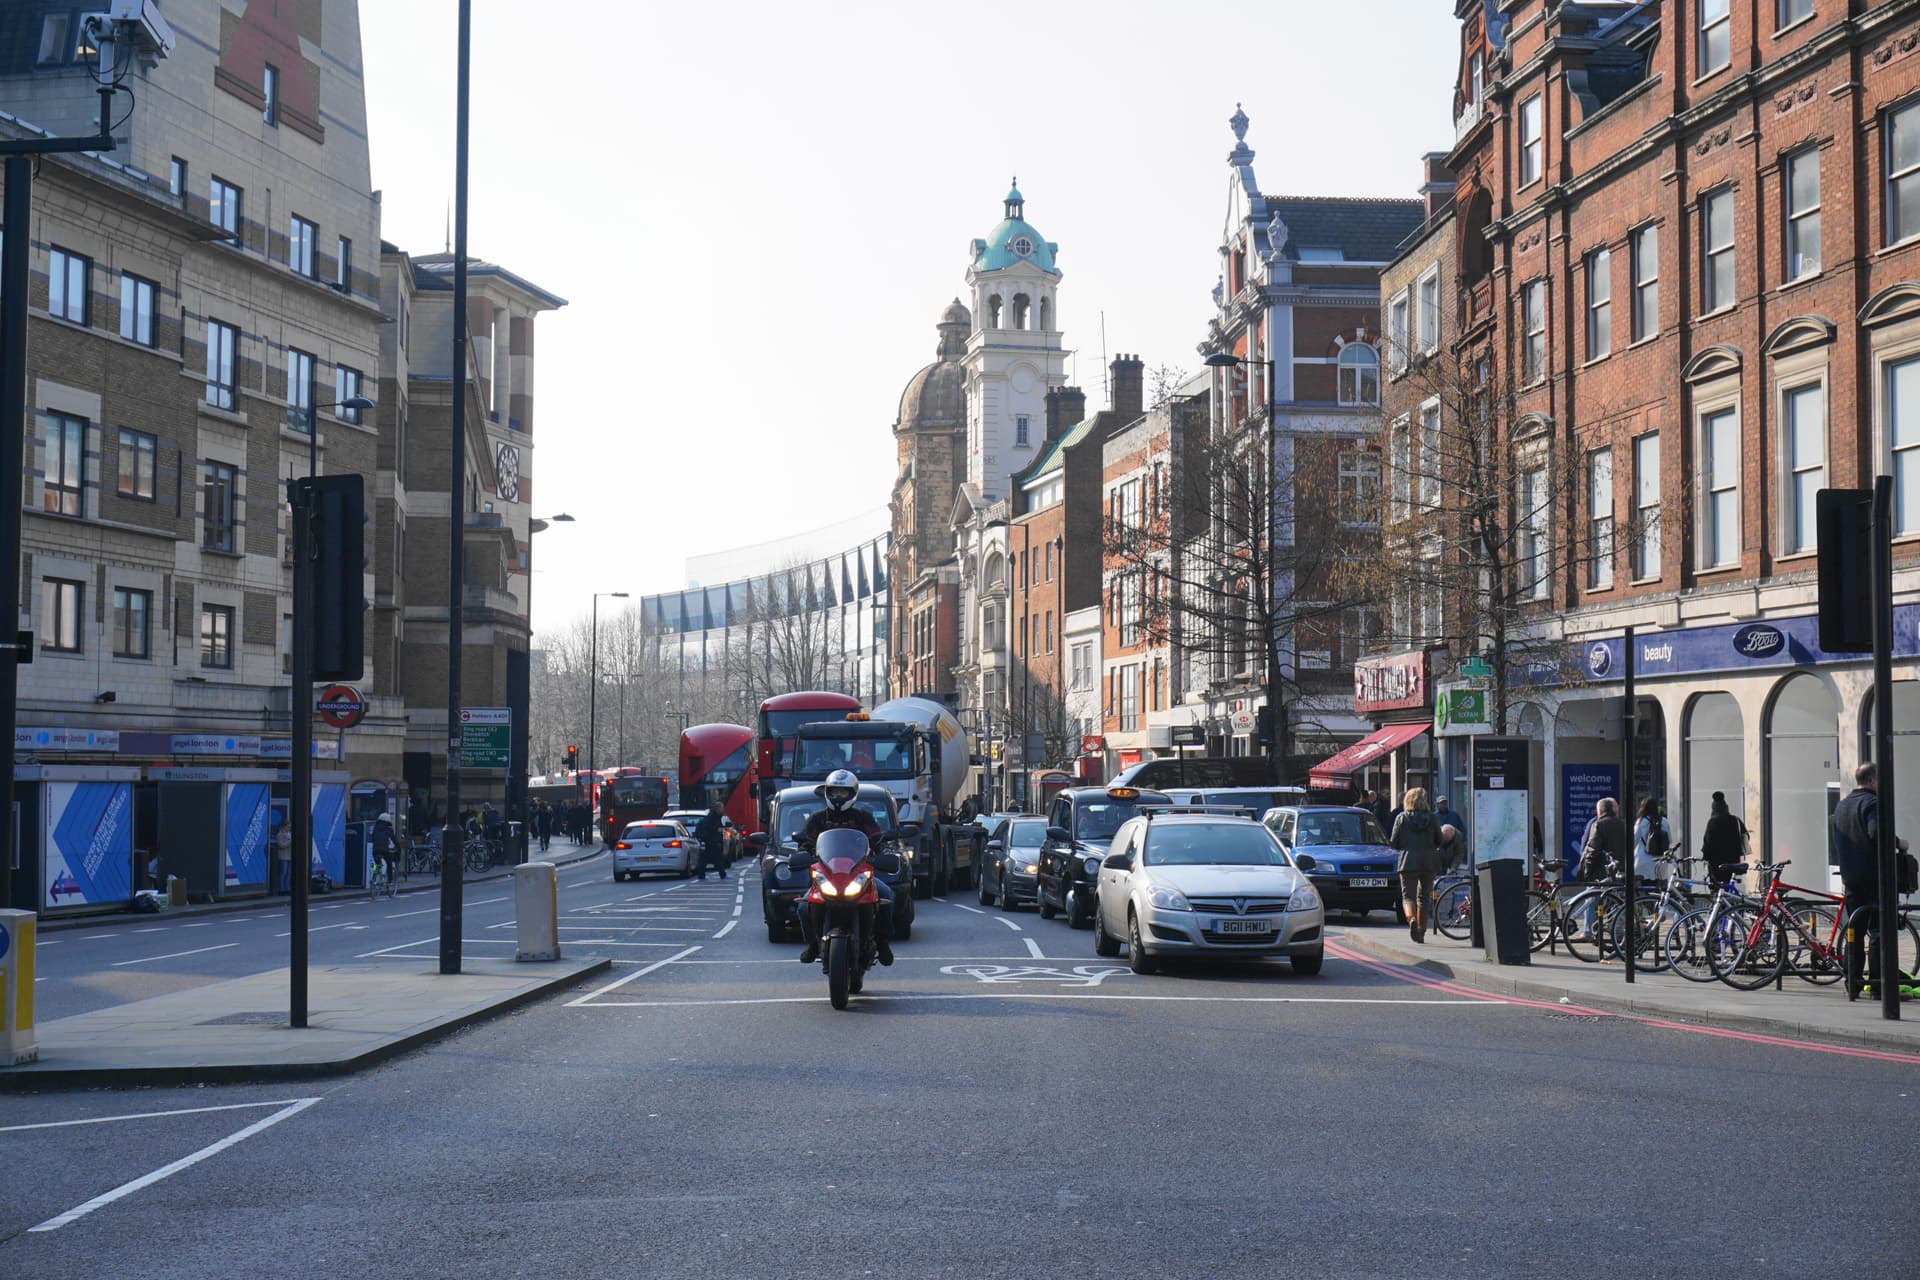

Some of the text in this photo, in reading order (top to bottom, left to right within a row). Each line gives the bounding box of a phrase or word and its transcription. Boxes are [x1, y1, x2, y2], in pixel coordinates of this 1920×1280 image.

[1744, 631, 1779, 651] Boots
[1644, 644, 1673, 663] beauty
[713, 771, 728, 782] 73
[1569, 773, 1612, 783] welcome
[1223, 921, 1244, 932] BG11
